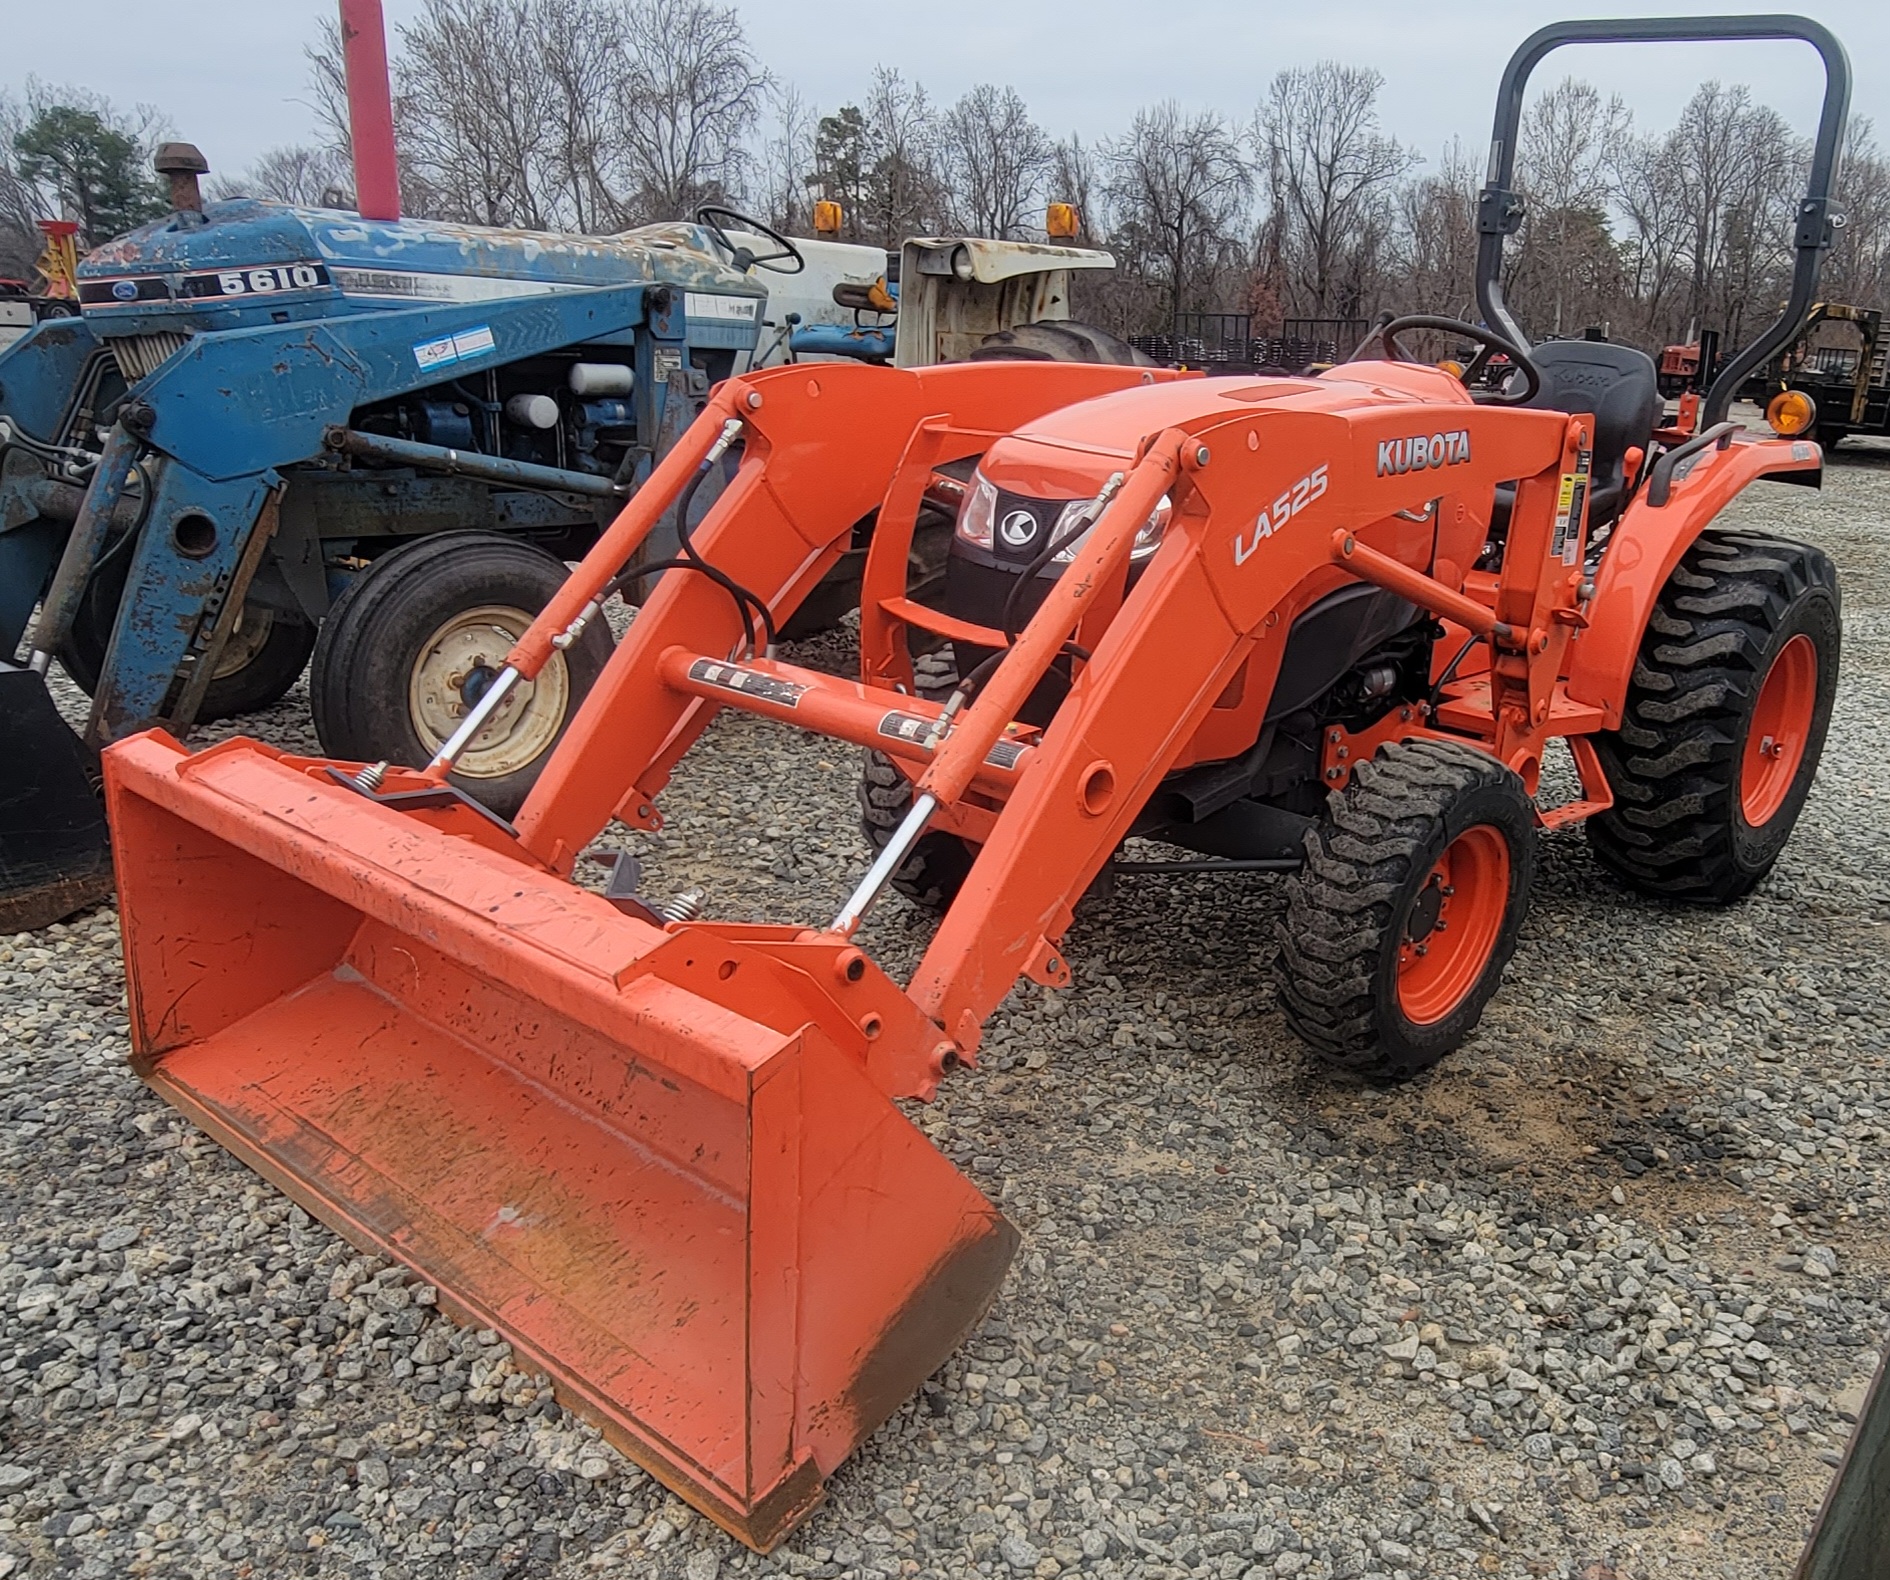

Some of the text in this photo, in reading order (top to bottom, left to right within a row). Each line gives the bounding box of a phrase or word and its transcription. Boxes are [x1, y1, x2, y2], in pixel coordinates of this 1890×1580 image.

[217, 265, 319, 295] 5610
[1376, 429, 1471, 477] KUBOTA
[1234, 463, 1329, 567] LA525
